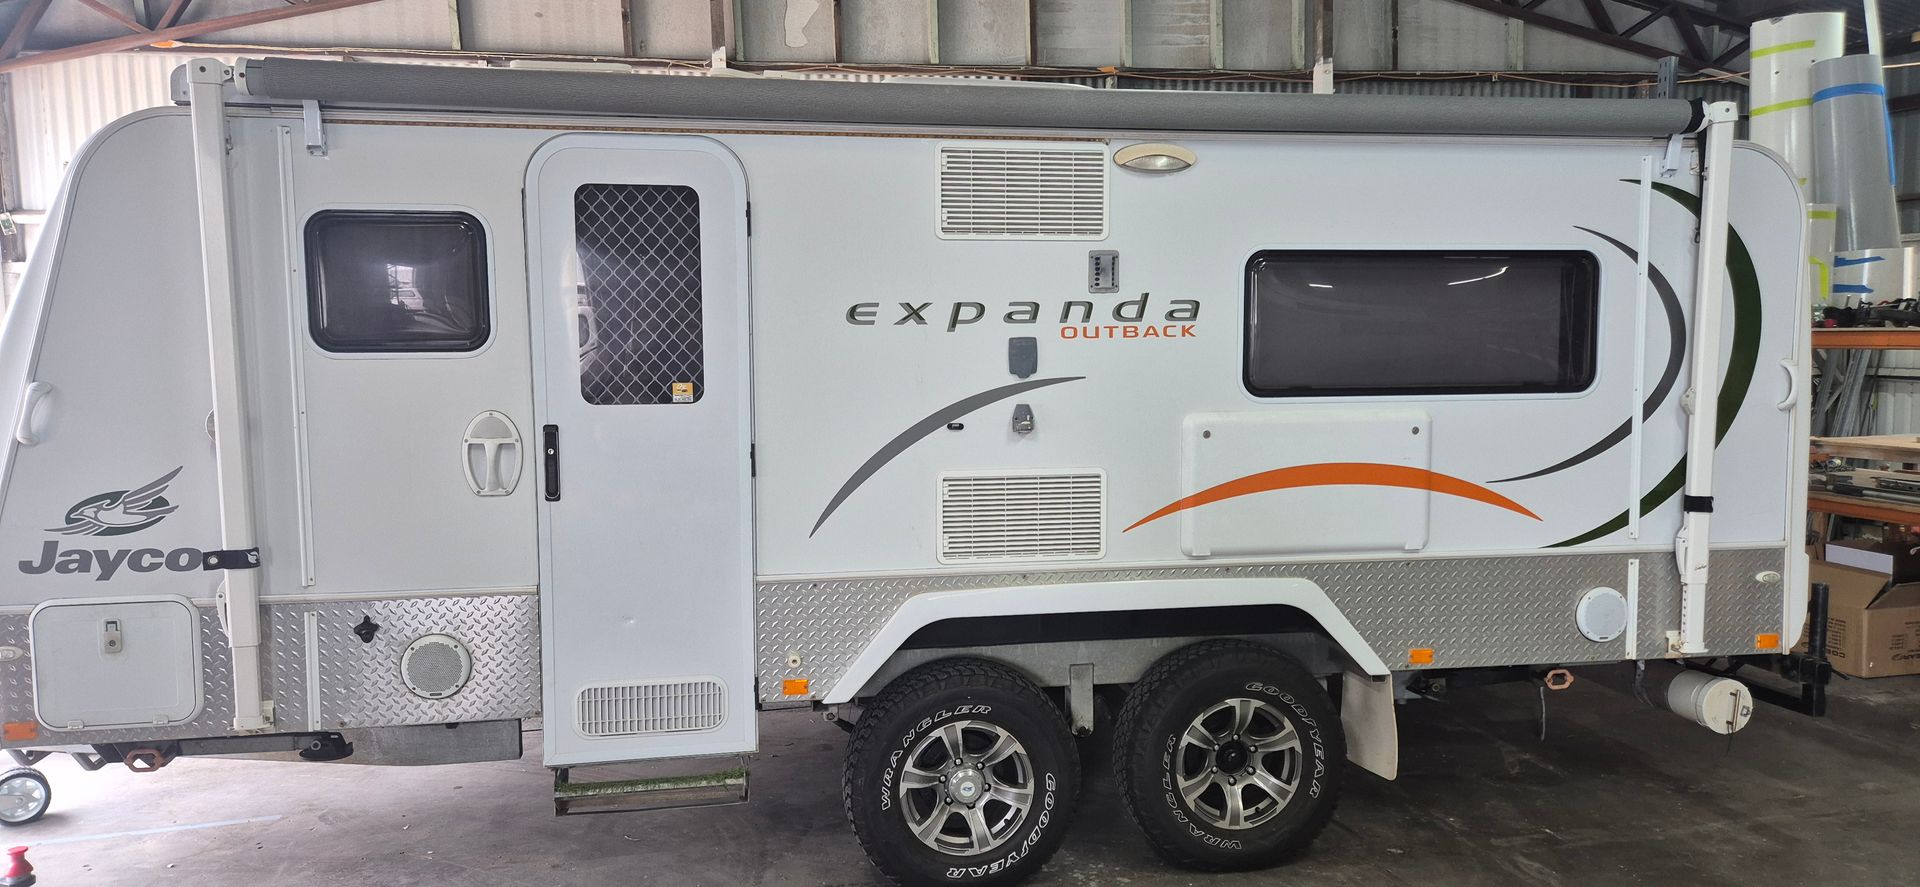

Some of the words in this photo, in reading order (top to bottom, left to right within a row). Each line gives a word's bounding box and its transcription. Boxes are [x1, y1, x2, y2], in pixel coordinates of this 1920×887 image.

[845, 292, 1201, 332] expanda
[1060, 324, 1197, 339] OUTBACK
[18, 540, 203, 581] Jayco
[882, 704, 992, 810] WRANGLER
[1162, 734, 1242, 849] WRANGLER
[1245, 682, 1325, 798] GOODYEAR
[946, 772, 1056, 878] GOODYEAR
